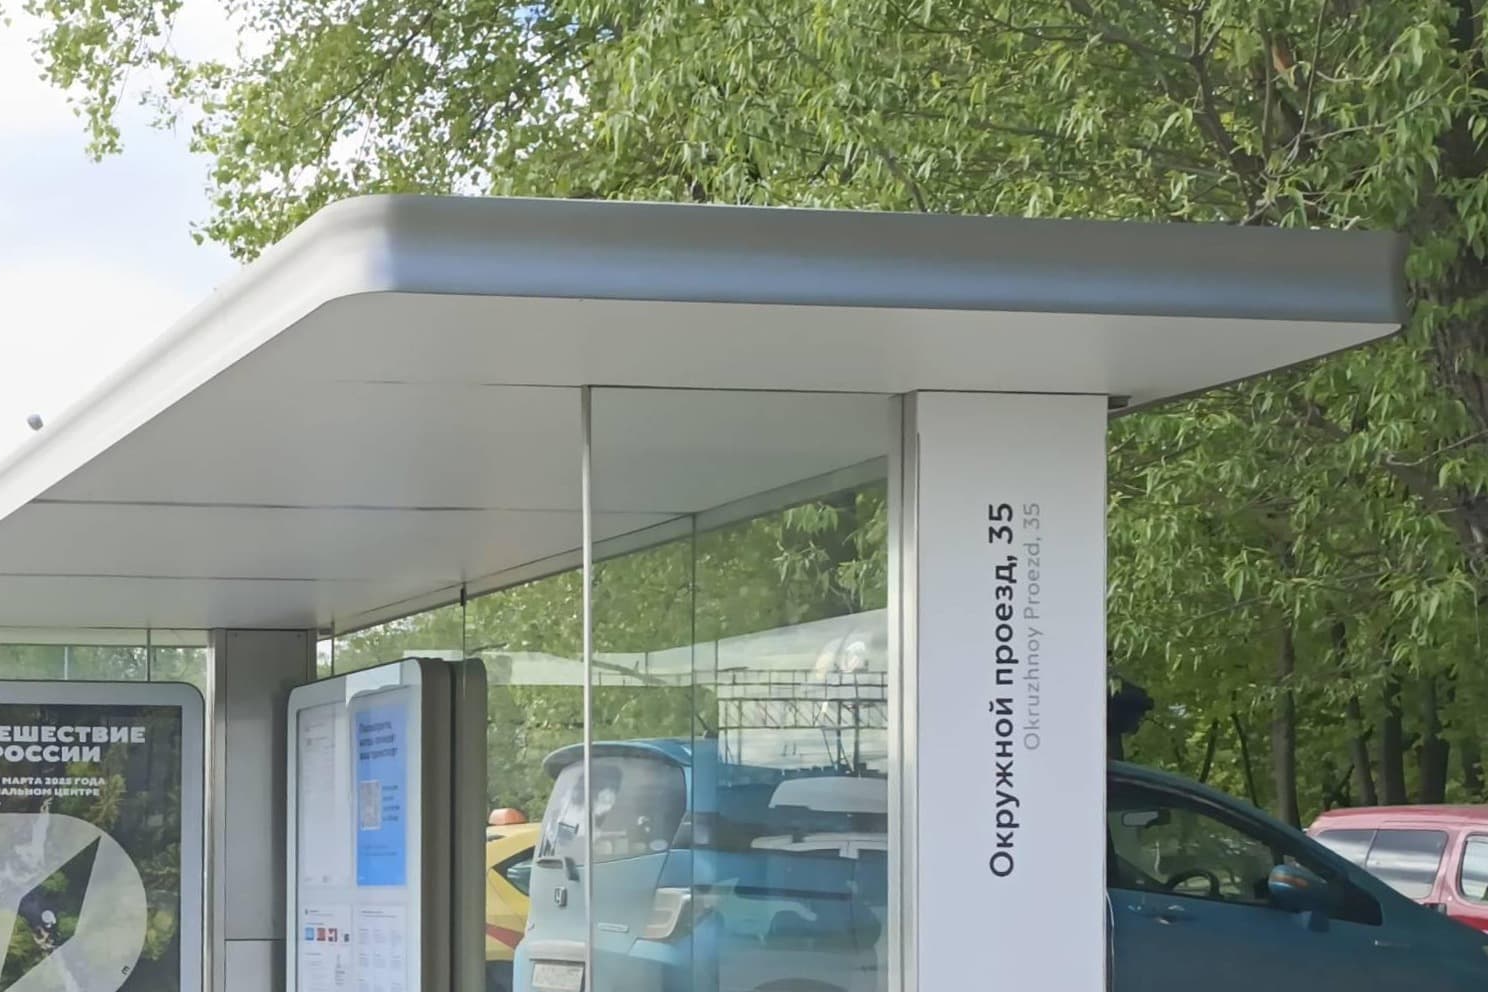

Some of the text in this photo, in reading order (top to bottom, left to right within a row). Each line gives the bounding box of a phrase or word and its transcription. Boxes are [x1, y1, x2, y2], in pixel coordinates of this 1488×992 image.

[988, 503, 1020, 877] Окружной проезд, 35
[1023, 503, 1044, 751] Okruzhnoy Proezd, 35
[2, 777, 43, 786] МАРТА
[74, 777, 106, 787] ГОДА
[54, 788, 100, 798] ЦЕНТРЕ
